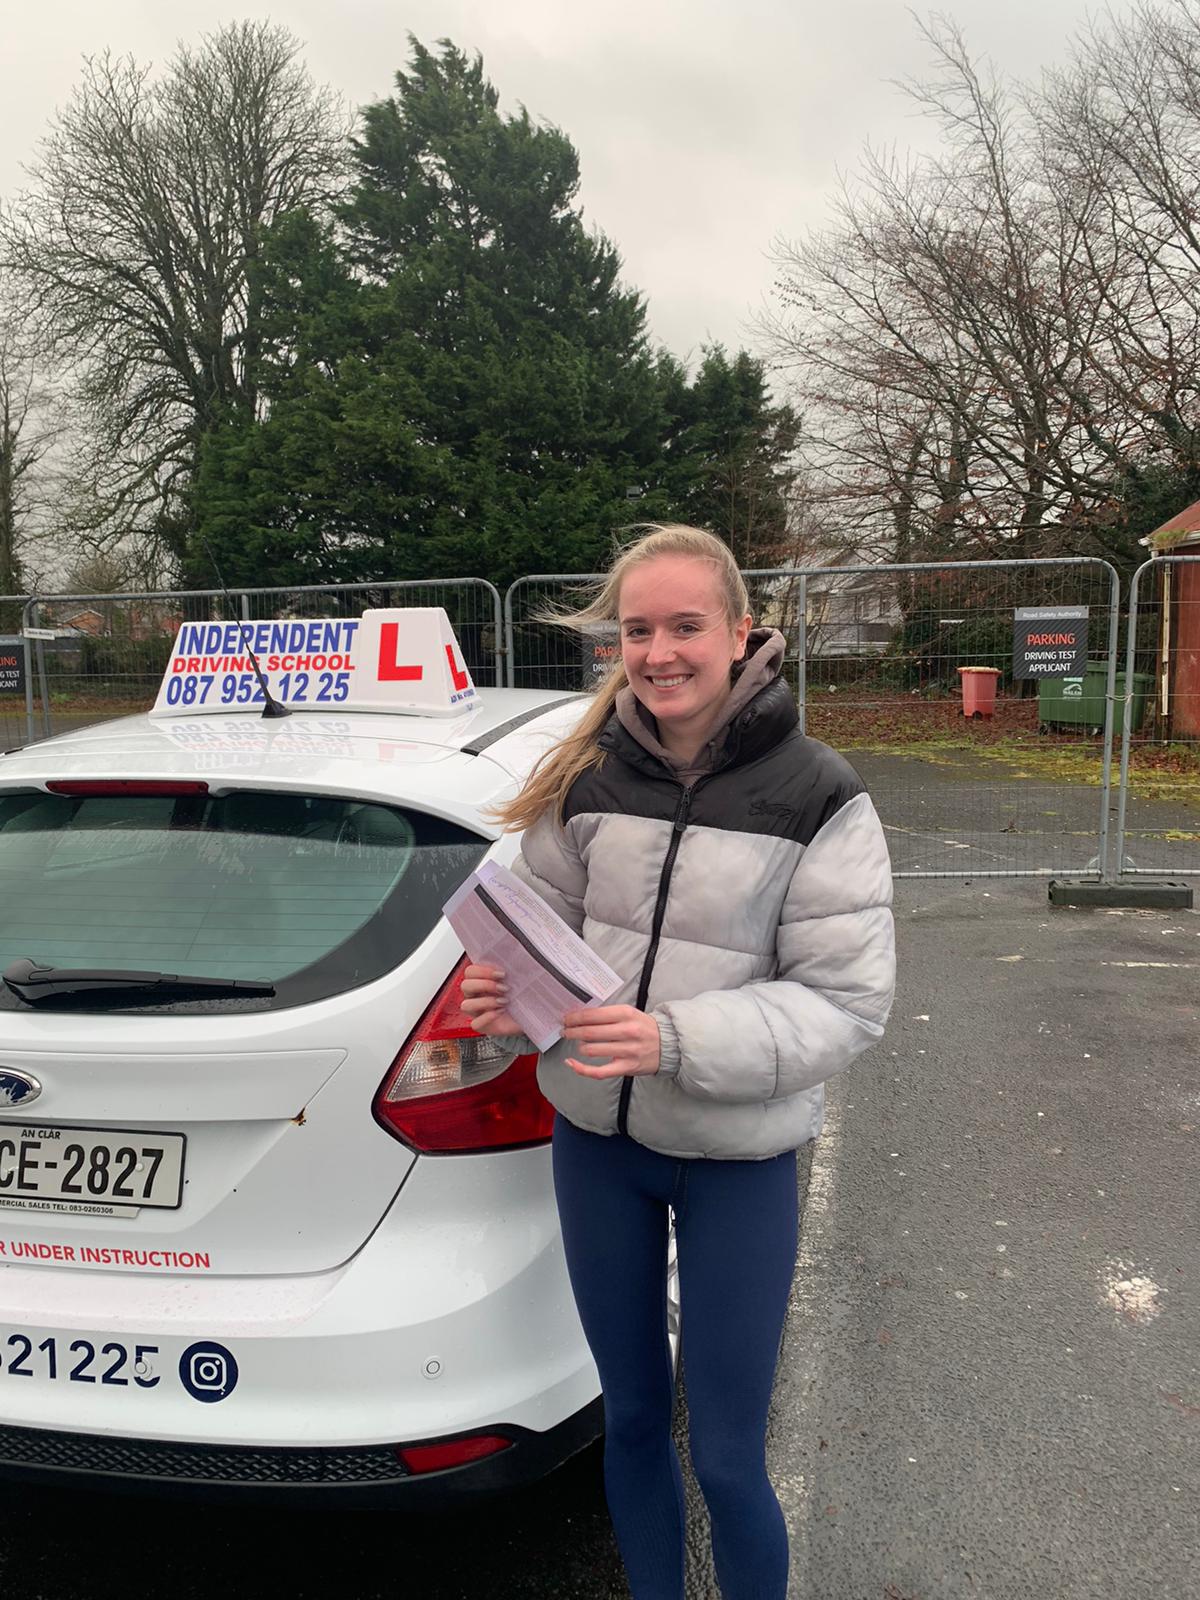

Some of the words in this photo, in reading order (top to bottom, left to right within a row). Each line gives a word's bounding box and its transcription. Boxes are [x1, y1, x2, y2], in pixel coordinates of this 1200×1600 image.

[178, 622, 358, 655] INDEPENDENT
[1026, 633, 1076, 646] PARKING
[378, 623, 423, 681] L
[1024, 651, 1057, 660] DRIVING
[1058, 650, 1077, 659] TEST
[6, 670, 20, 678] TEST
[172, 655, 260, 673] DRIVING
[267, 655, 355, 671] SCHOOL
[445, 644, 468, 691] L
[1029, 663, 1072, 672] APPLICANT
[167, 675, 214, 705] 087
[220, 674, 269, 704] 952
[278, 673, 309, 703] 12
[316, 672, 350, 702] 25
[21, 1129, 36, 1138] AN
[38, 1128, 61, 1140] CLÁR
[0, 1139, 164, 1198] CE-2827
[28, 1202, 50, 1210] SALES
[11, 1242, 75, 1261] UNDER
[81, 1247, 211, 1268] INSTRUCTION
[0, 1334, 161, 1387] 21225
